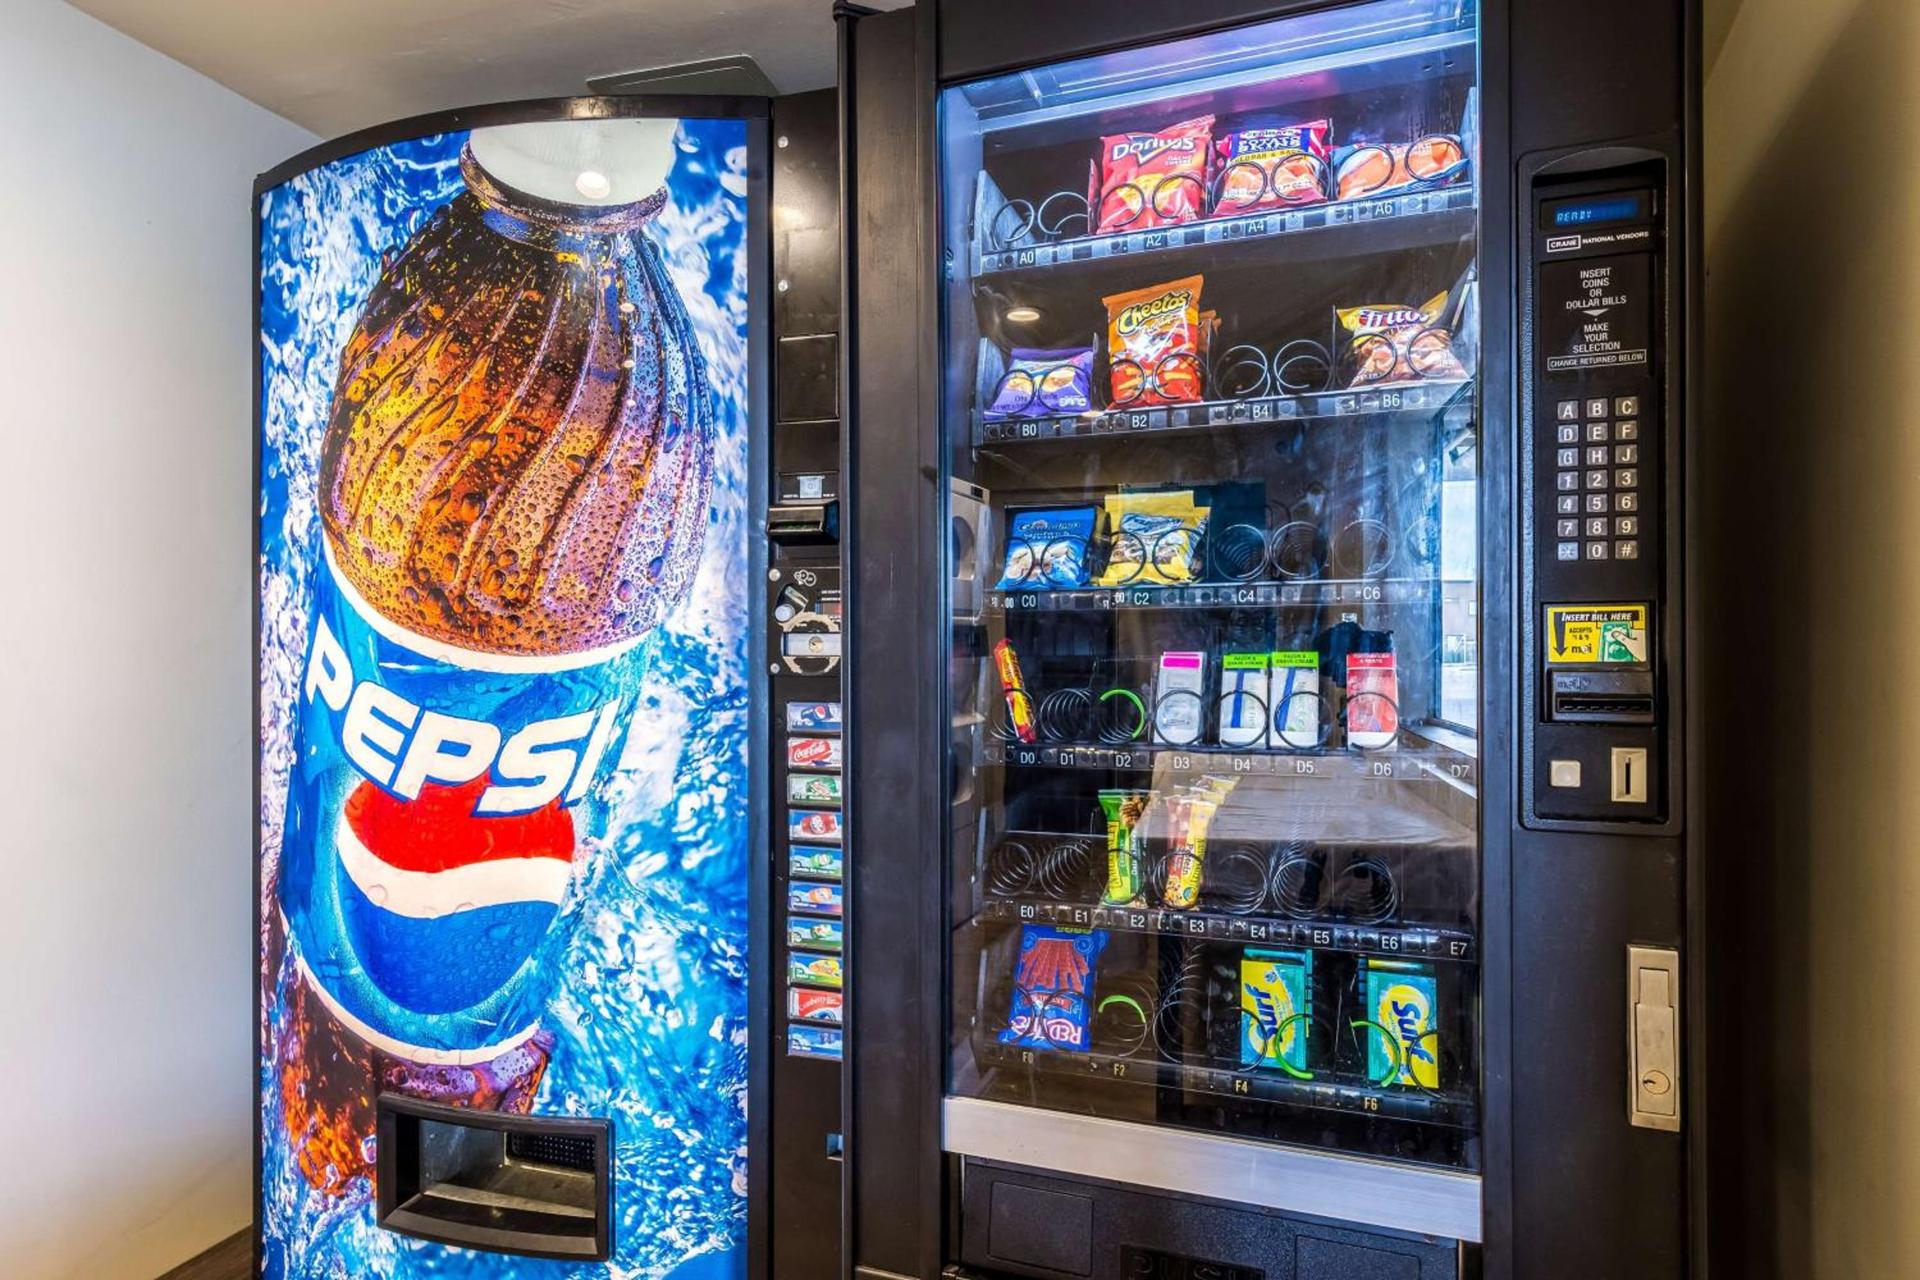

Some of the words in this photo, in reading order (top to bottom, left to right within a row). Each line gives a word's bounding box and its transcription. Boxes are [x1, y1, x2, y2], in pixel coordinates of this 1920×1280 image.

[1112, 136, 1194, 161] Doritos
[1019, 250, 1034, 265] A0
[1146, 233, 1162, 247] A2
[1248, 219, 1264, 232] A4
[1375, 202, 1393, 215] A6
[1550, 239, 1577, 249] CRANE
[1582, 235, 1614, 244] NATIONAL
[1616, 231, 1649, 241] VENDORS
[1580, 267, 1611, 279] INSERT
[1582, 278, 1610, 288] COINS
[1589, 288, 1602, 297] OR
[1566, 298, 1600, 309] DOLLAR
[1602, 295, 1627, 305] BILLS
[1118, 291, 1190, 334] Cheetos
[1584, 323, 1609, 333] MAKE
[1584, 332, 1609, 342] YOUR
[1572, 342, 1621, 353] SELECTION
[1550, 357, 1578, 368] CHANGE
[1580, 354, 1617, 365] RETURNED
[1618, 352, 1644, 362] BELOW
[1022, 424, 1037, 436] B0
[1132, 415, 1147, 427] B2
[1252, 405, 1269, 418] B4
[1383, 393, 1400, 407] B6
[1563, 405, 1573, 418] A
[1593, 403, 1601, 415] B
[1622, 401, 1632, 414] C
[1564, 428, 1572, 441] D
[1593, 427, 1601, 439] E
[1622, 424, 1631, 437] F
[1563, 452, 1573, 465] G
[1592, 451, 1601, 463] H
[1621, 449, 1630, 461] J
[1564, 476, 1571, 488] 1
[1593, 475, 1601, 487] 2
[1622, 472, 1631, 485] 3
[1563, 499, 1572, 511] 4
[1593, 498, 1601, 510] 5
[1622, 496, 1631, 509] 6
[1563, 523, 1573, 535] 7
[1592, 522, 1601, 534] 8
[1622, 520, 1631, 533] 9
[1592, 545, 1601, 557] 0
[1621, 544, 1632, 556] #
[1022, 595, 1036, 607] C0
[1134, 592, 1149, 605] C2
[1238, 589, 1255, 602] C4
[1362, 587, 1381, 600] C6
[1562, 612, 1590, 621] INSERT
[1591, 613, 1608, 621] BILL
[1610, 612, 1632, 620] HERE
[306, 613, 621, 813] PEPSI
[1020, 752, 1035, 764] D0
[1060, 753, 1074, 765] D1
[1116, 755, 1131, 768] D2
[1173, 756, 1190, 769] D3
[1234, 758, 1251, 771] D4
[1296, 760, 1314, 774] D5
[1374, 762, 1392, 776] D6
[1452, 764, 1469, 778] D7
[1020, 906, 1034, 918] E0
[1075, 910, 1088, 923] E1
[1131, 915, 1145, 928] E2
[1189, 919, 1205, 933] E3
[1250, 925, 1266, 938] E4
[1313, 931, 1330, 944] E5
[1381, 936, 1399, 950] E6
[1450, 942, 1468, 955] E7
[1114, 1065, 1125, 1076] F2
[1235, 1081, 1248, 1093] F4
[1364, 1098, 1377, 1111] F6
